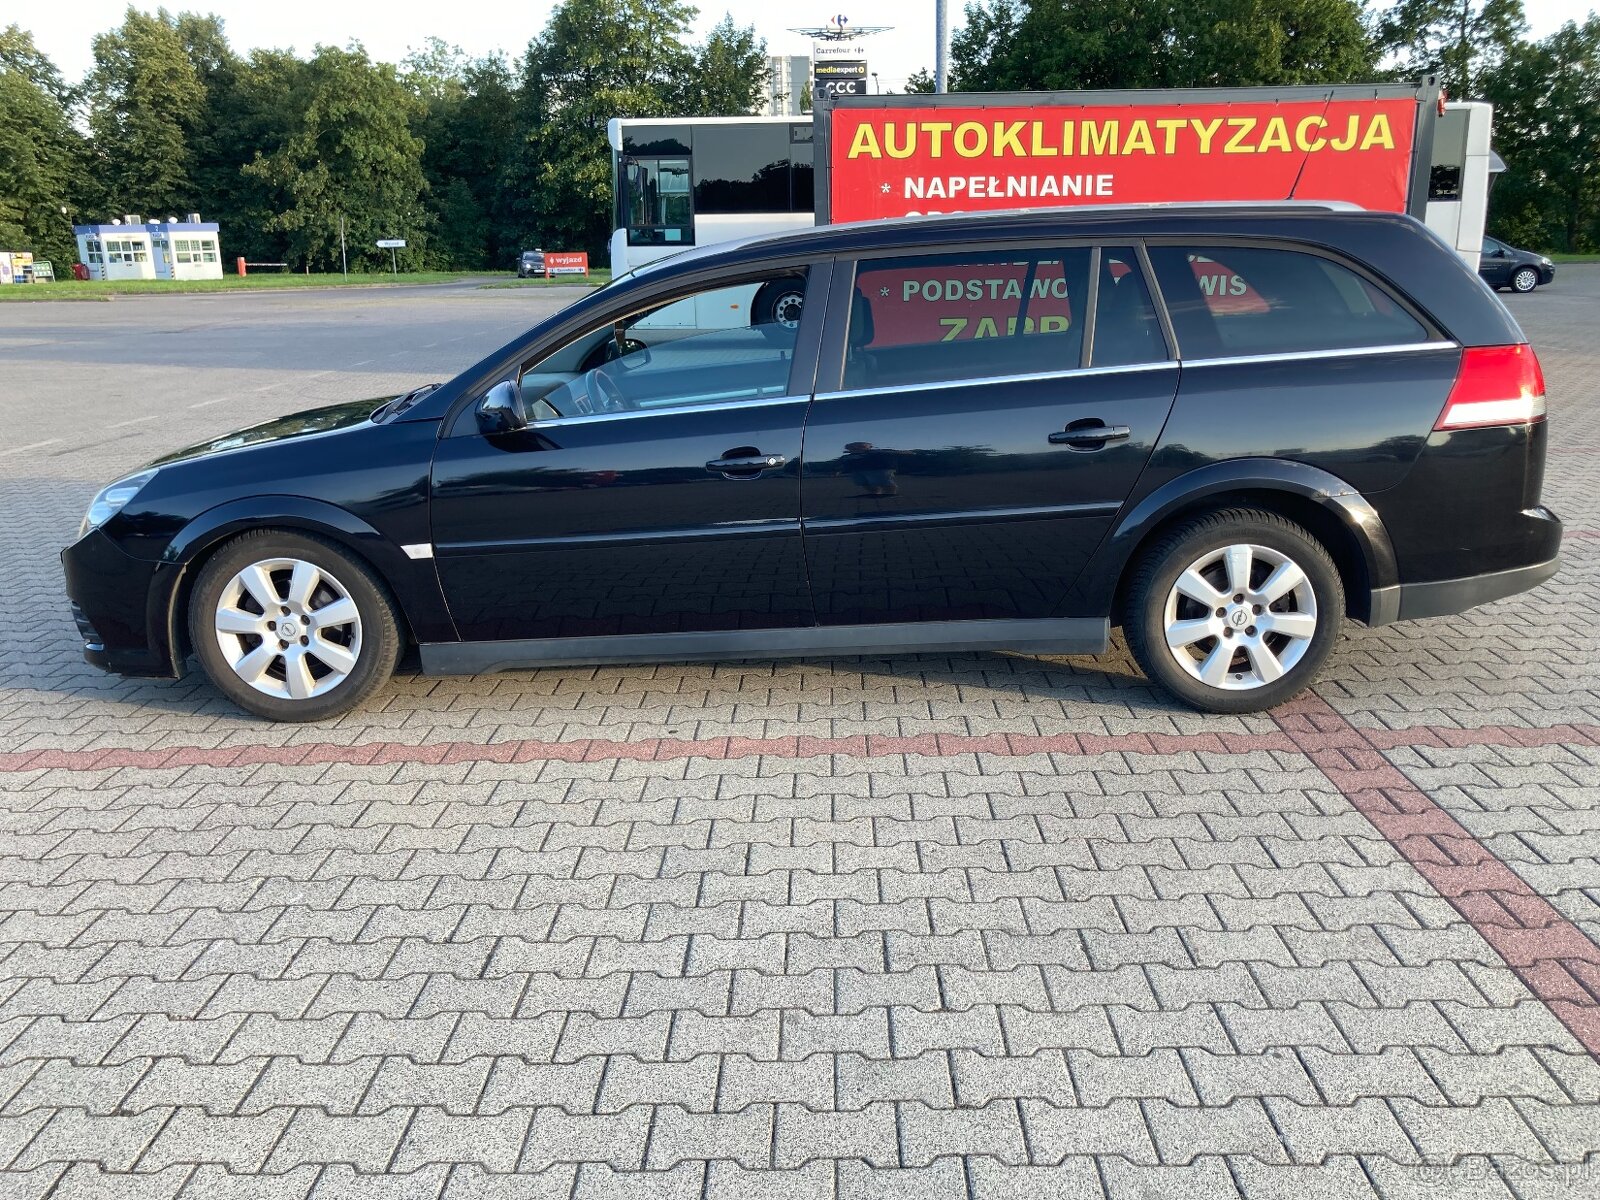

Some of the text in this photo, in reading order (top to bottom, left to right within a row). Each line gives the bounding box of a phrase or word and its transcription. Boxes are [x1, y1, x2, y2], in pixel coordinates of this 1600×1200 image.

[816, 66, 858, 74] mediaexpert
[826, 82, 856, 94] CCC
[847, 113, 1395, 159] AUTOKLIMATYZACJA
[904, 174, 1114, 199] NAPEŁNIANIE
[903, 279, 1069, 302] PODSTAWO
